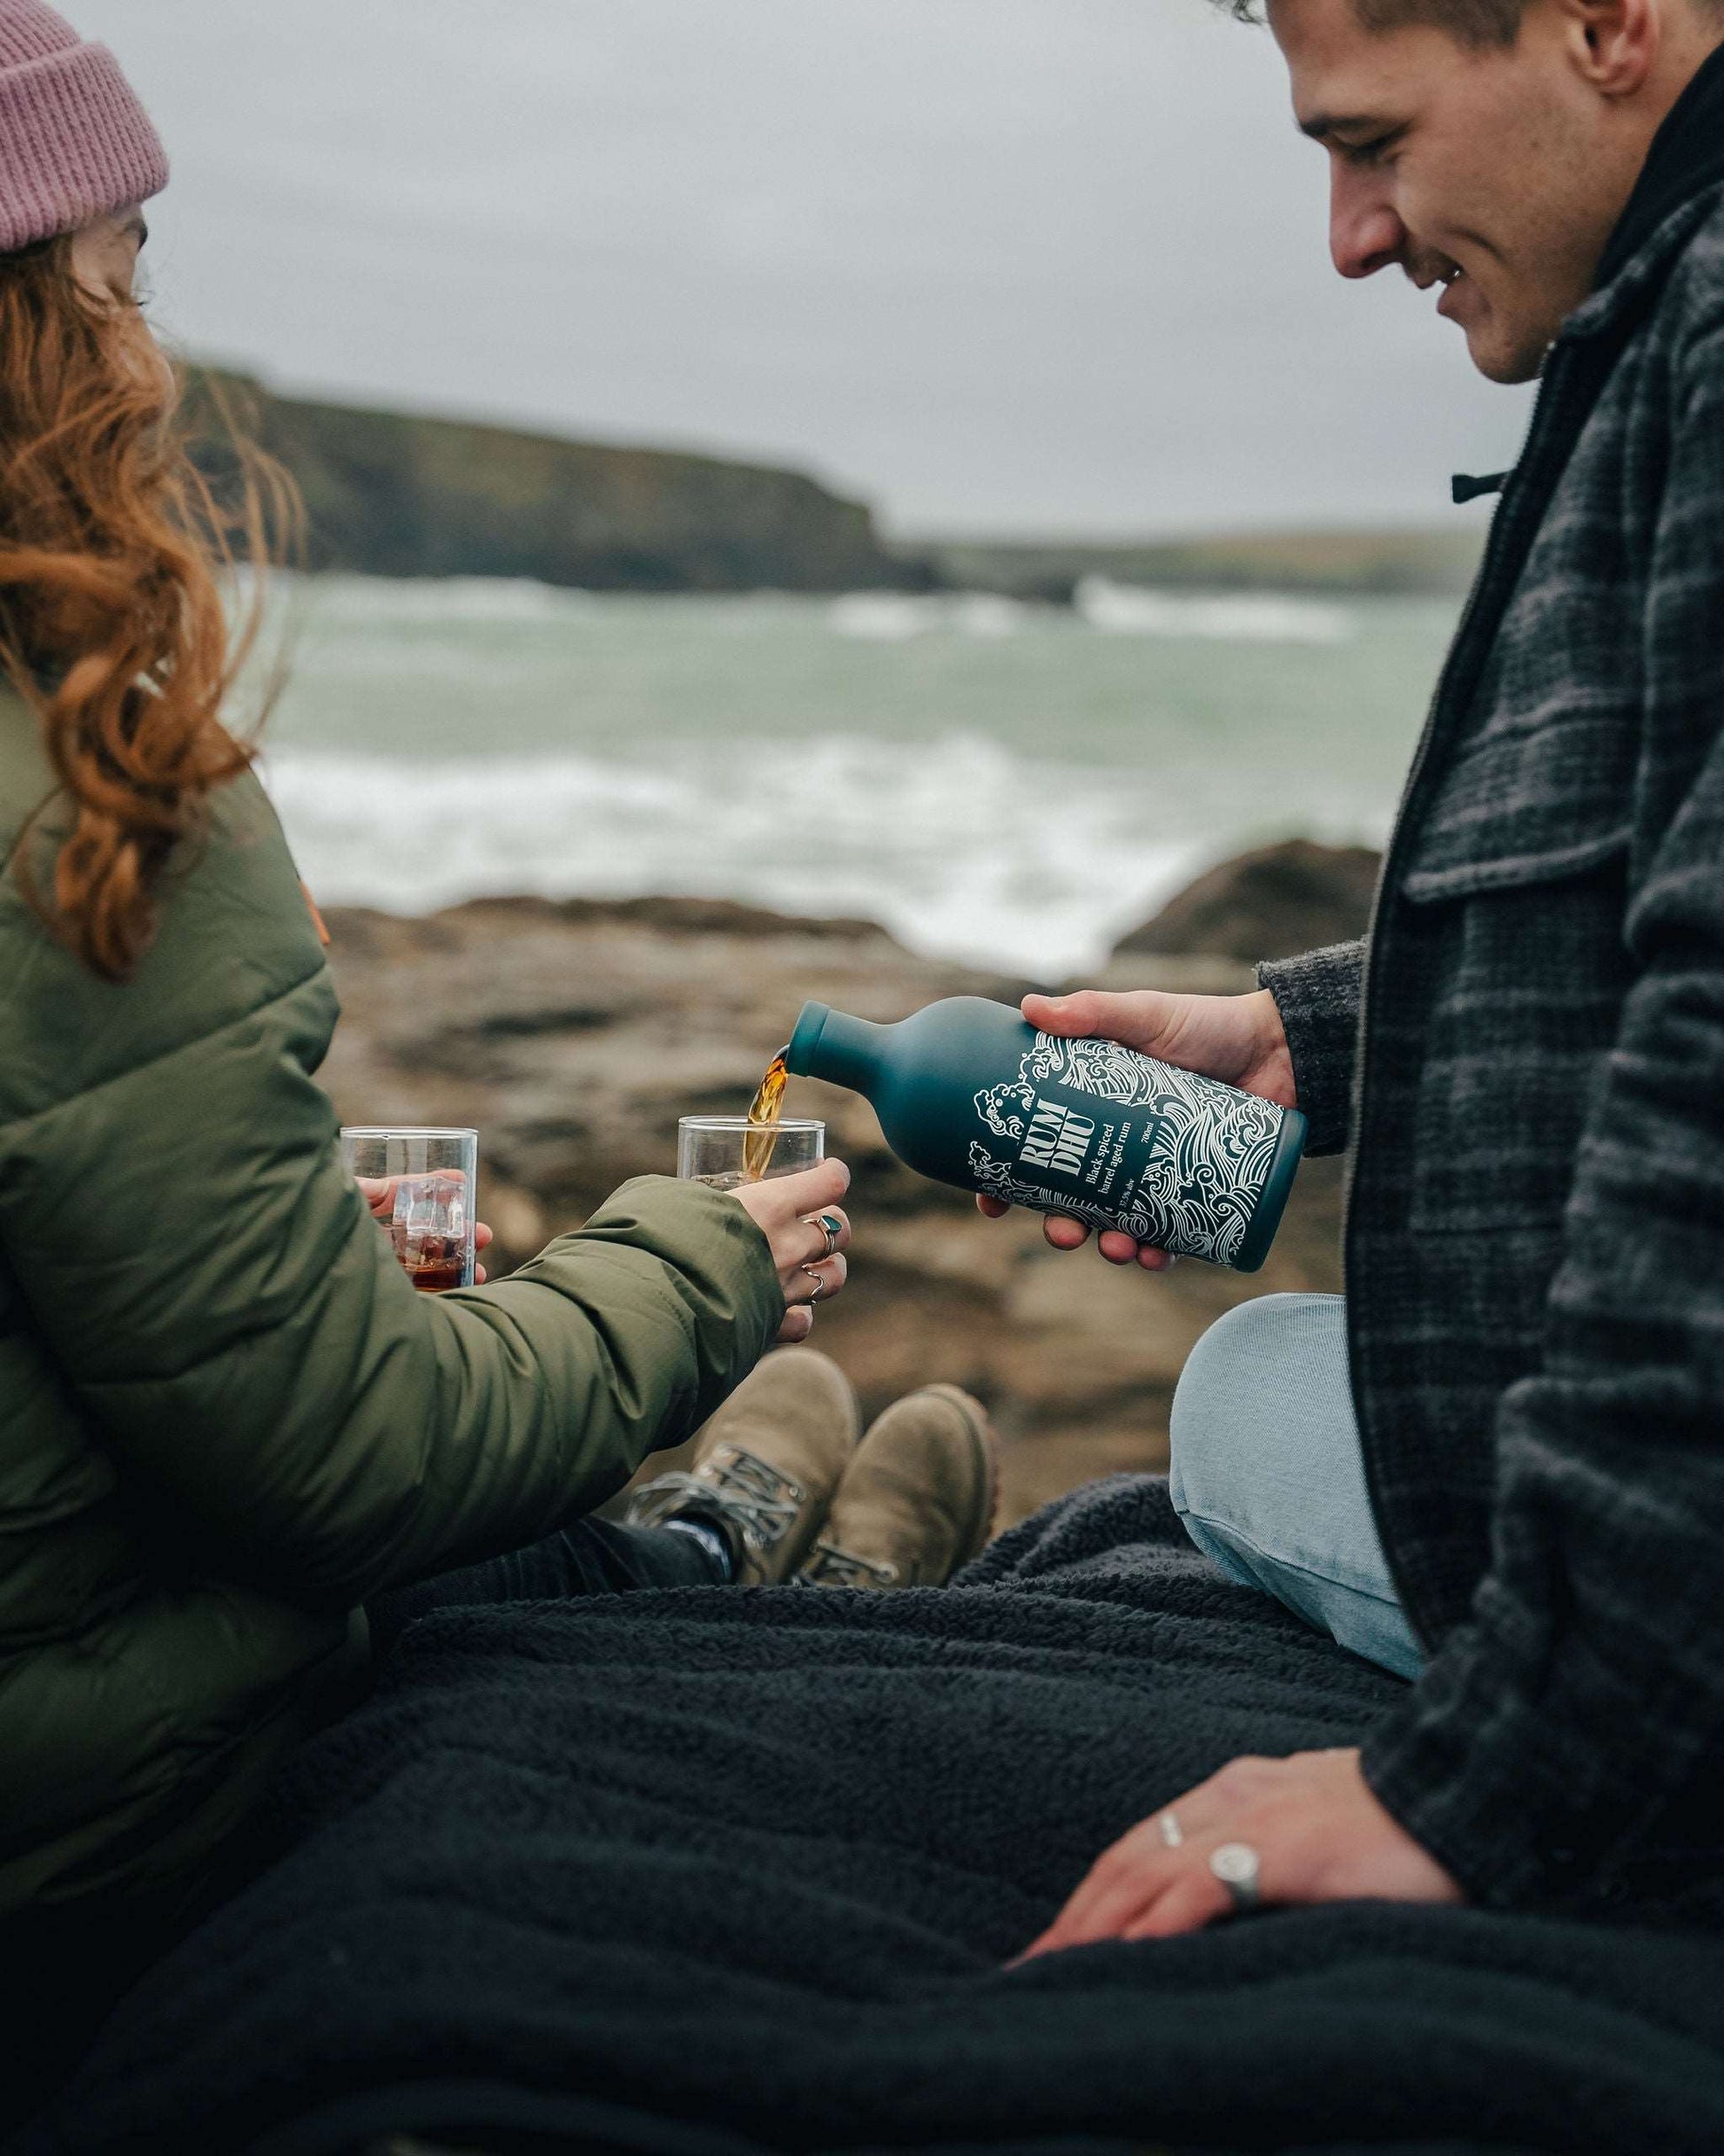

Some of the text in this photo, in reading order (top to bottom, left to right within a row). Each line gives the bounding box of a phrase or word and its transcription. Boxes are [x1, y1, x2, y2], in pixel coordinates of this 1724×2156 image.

[1020, 1098, 1068, 1168] RUM
[1050, 1110, 1095, 1177] DHU
[1085, 1124, 1114, 1185] Black spiced
[1098, 1122, 1131, 1194] barrel aged rum
[1140, 1122, 1154, 1143] 700ml
[1125, 1179, 1135, 1191] abv
